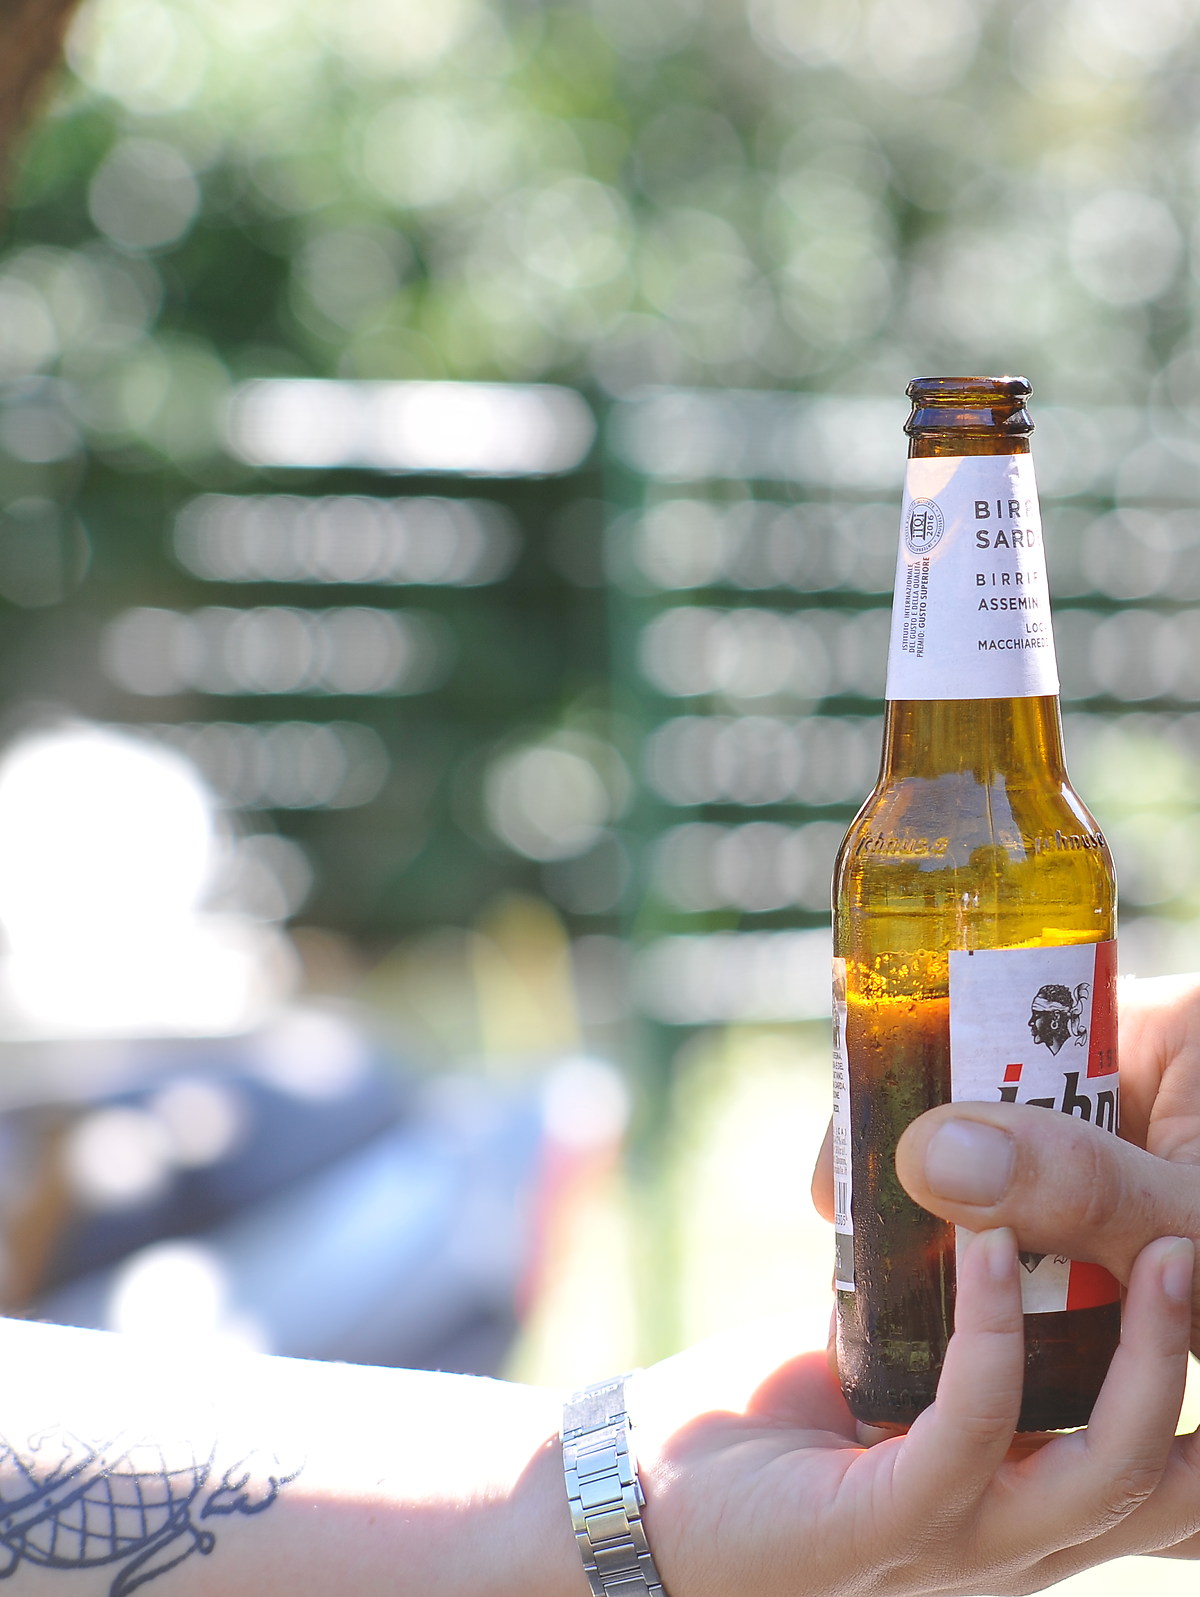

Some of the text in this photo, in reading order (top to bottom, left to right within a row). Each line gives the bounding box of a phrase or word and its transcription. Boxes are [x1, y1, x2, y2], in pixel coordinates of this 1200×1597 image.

[926, 514, 935, 537] 2016
[975, 529, 1041, 549] SARD
[904, 564, 913, 619] INTERNAZIONALE
[911, 590, 919, 610] DELLA
[917, 557, 930, 658] PREMIO: GUSTO SUPERIORE
